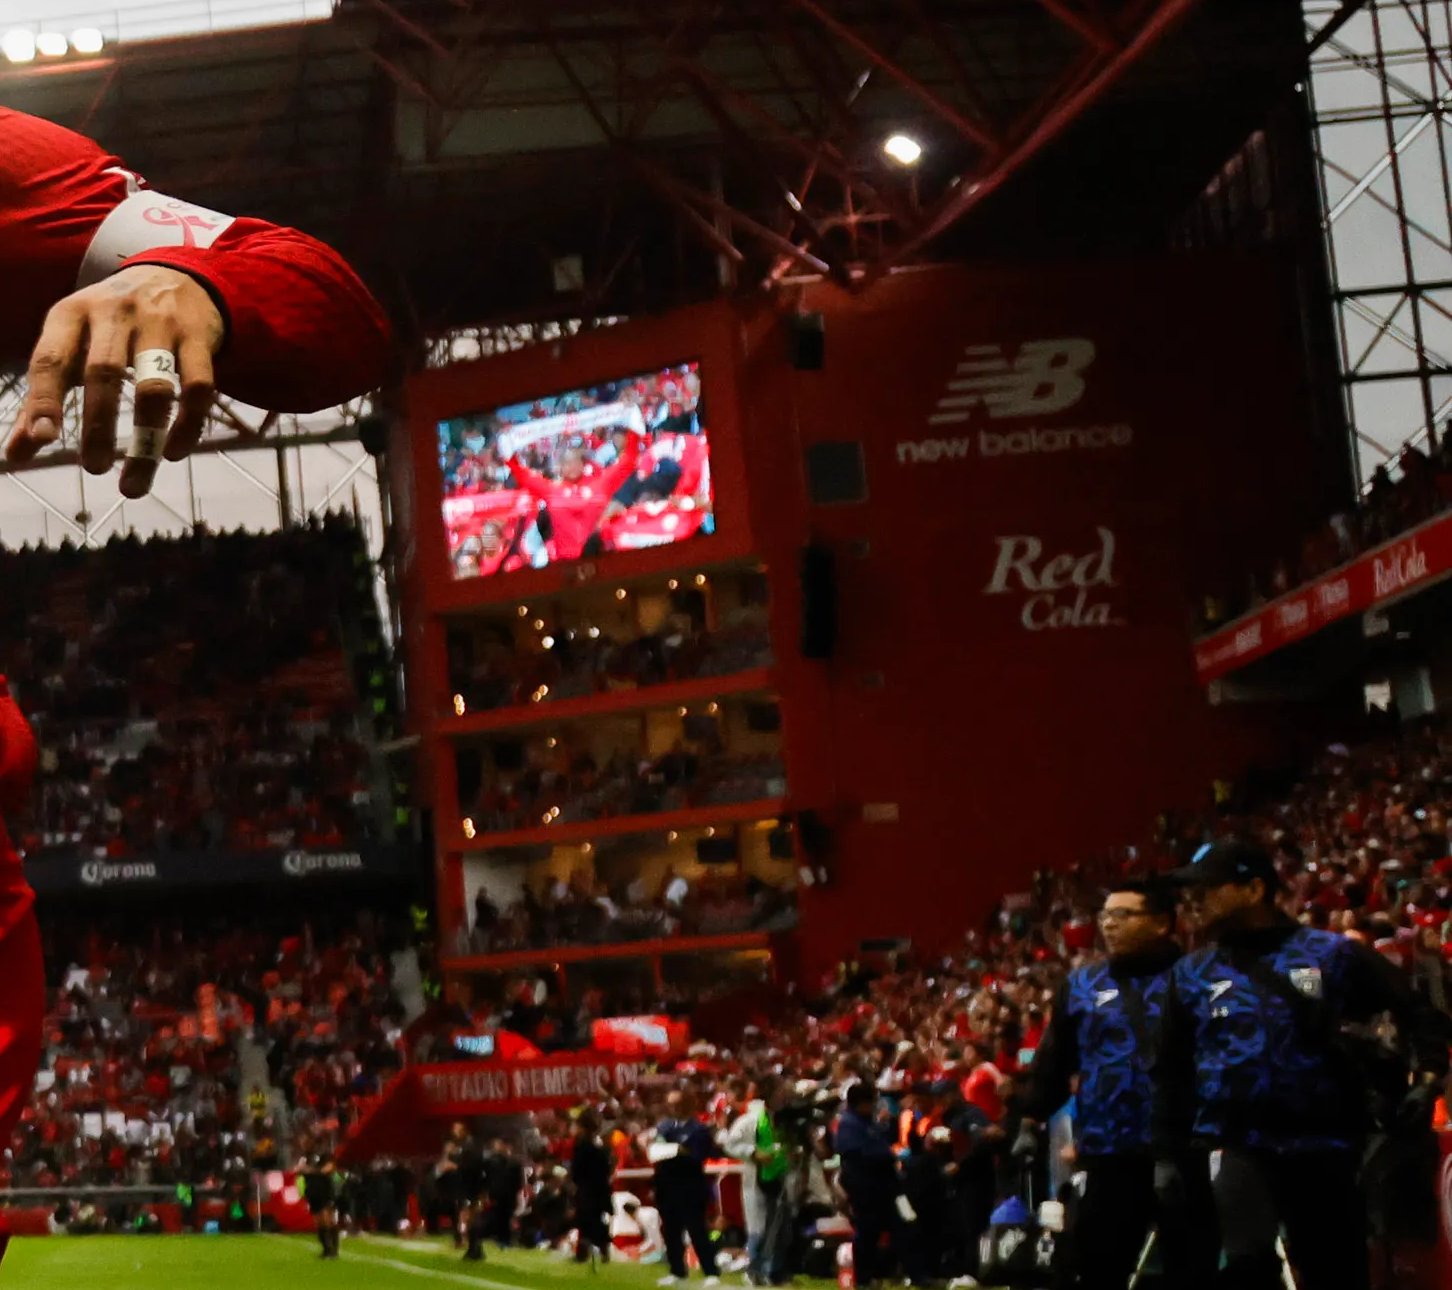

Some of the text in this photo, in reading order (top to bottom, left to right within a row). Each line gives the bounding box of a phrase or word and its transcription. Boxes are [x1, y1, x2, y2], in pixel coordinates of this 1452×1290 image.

[896, 423, 1133, 466] new balance
[981, 525, 1119, 594] Red
[1022, 588, 1117, 630] Cola
[81, 861, 156, 885] Corona
[283, 850, 361, 876] Corona
